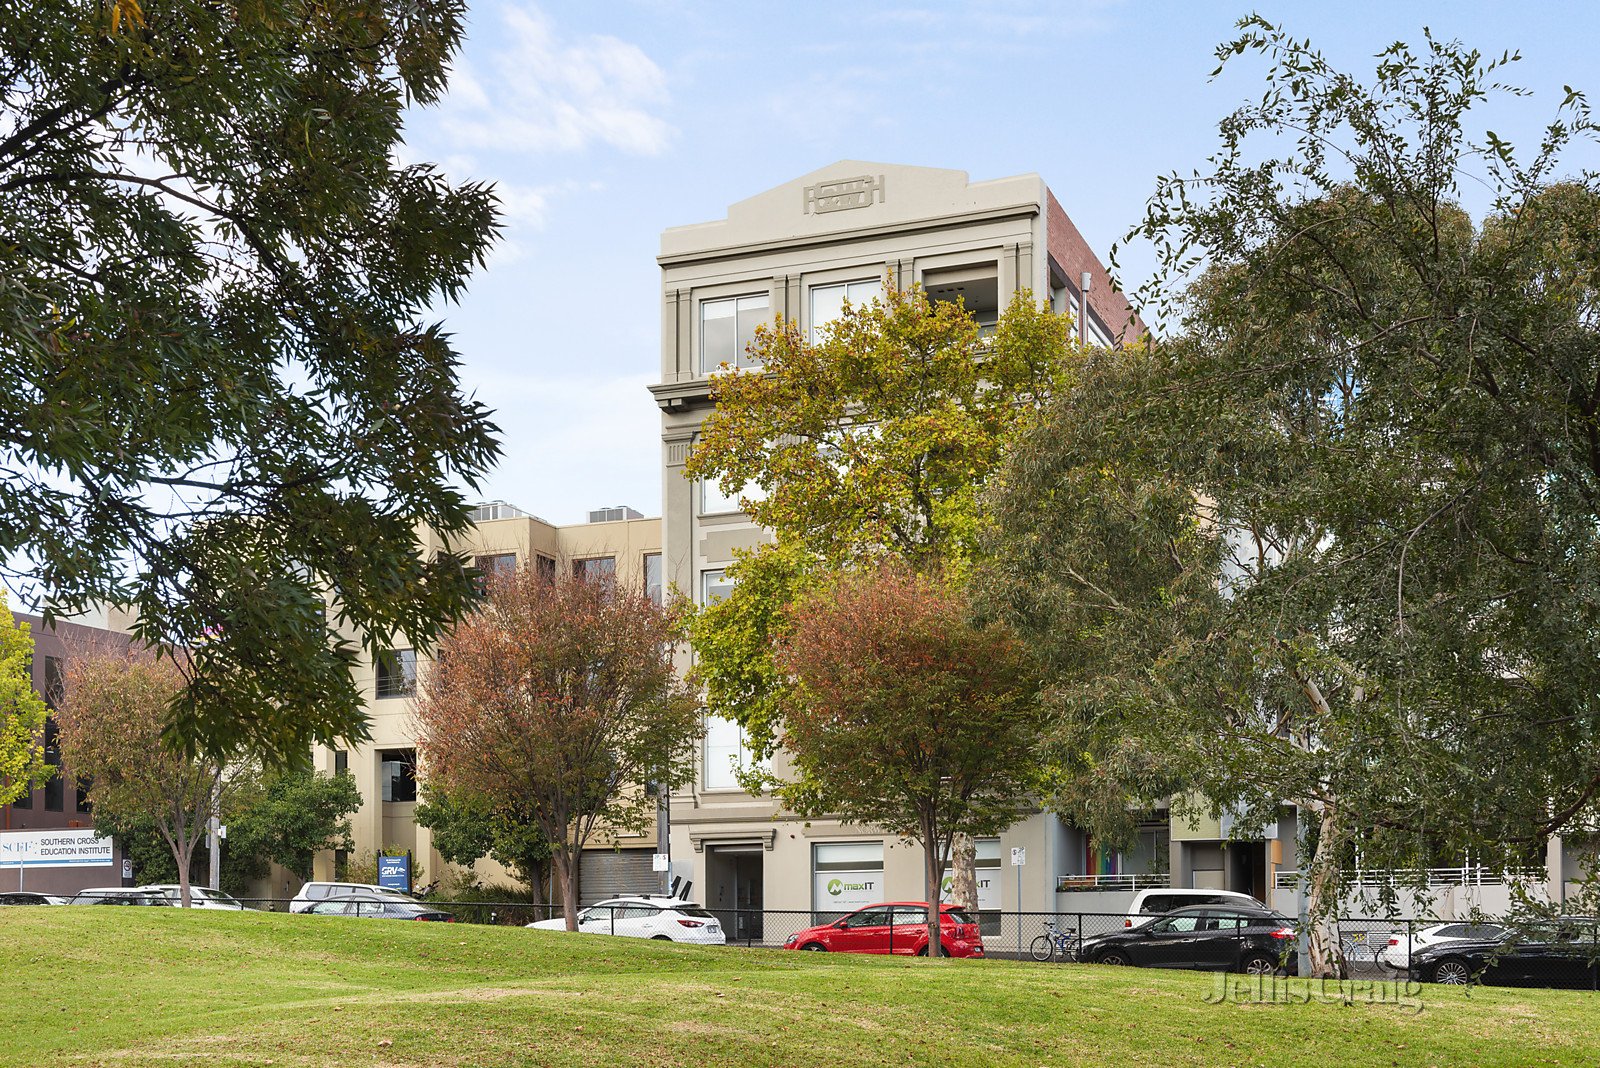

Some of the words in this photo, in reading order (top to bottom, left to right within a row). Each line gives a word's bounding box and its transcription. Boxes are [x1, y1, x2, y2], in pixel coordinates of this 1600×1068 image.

[41, 838, 75, 846] SOUTHERN
[77, 837, 99, 845] CROSS
[41, 847, 77, 855] EDUCATION
[79, 846, 110, 855] INSTITUTE
[843, 881, 875, 891] maxIT
